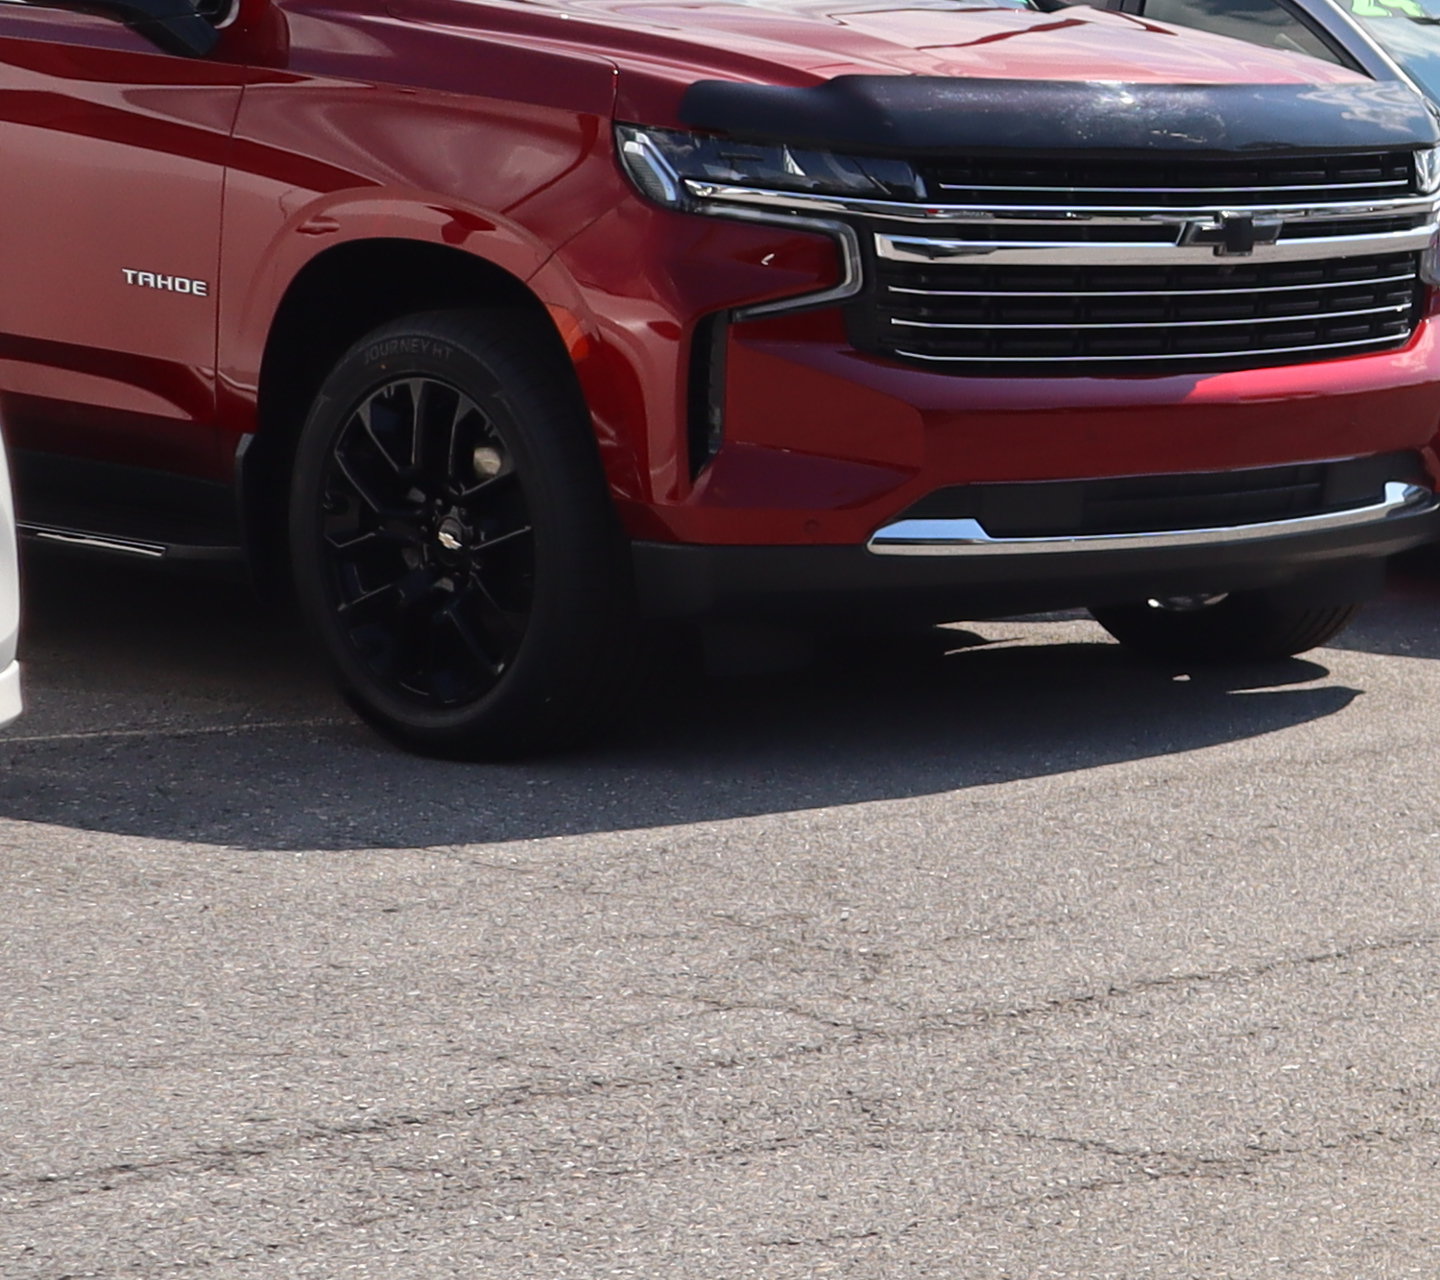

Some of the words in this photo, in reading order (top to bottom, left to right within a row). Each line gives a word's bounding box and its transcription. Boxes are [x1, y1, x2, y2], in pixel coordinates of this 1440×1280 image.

[121, 267, 209, 297] TAHOE
[364, 338, 430, 365] JOURNEY
[432, 342, 454, 359] HT
